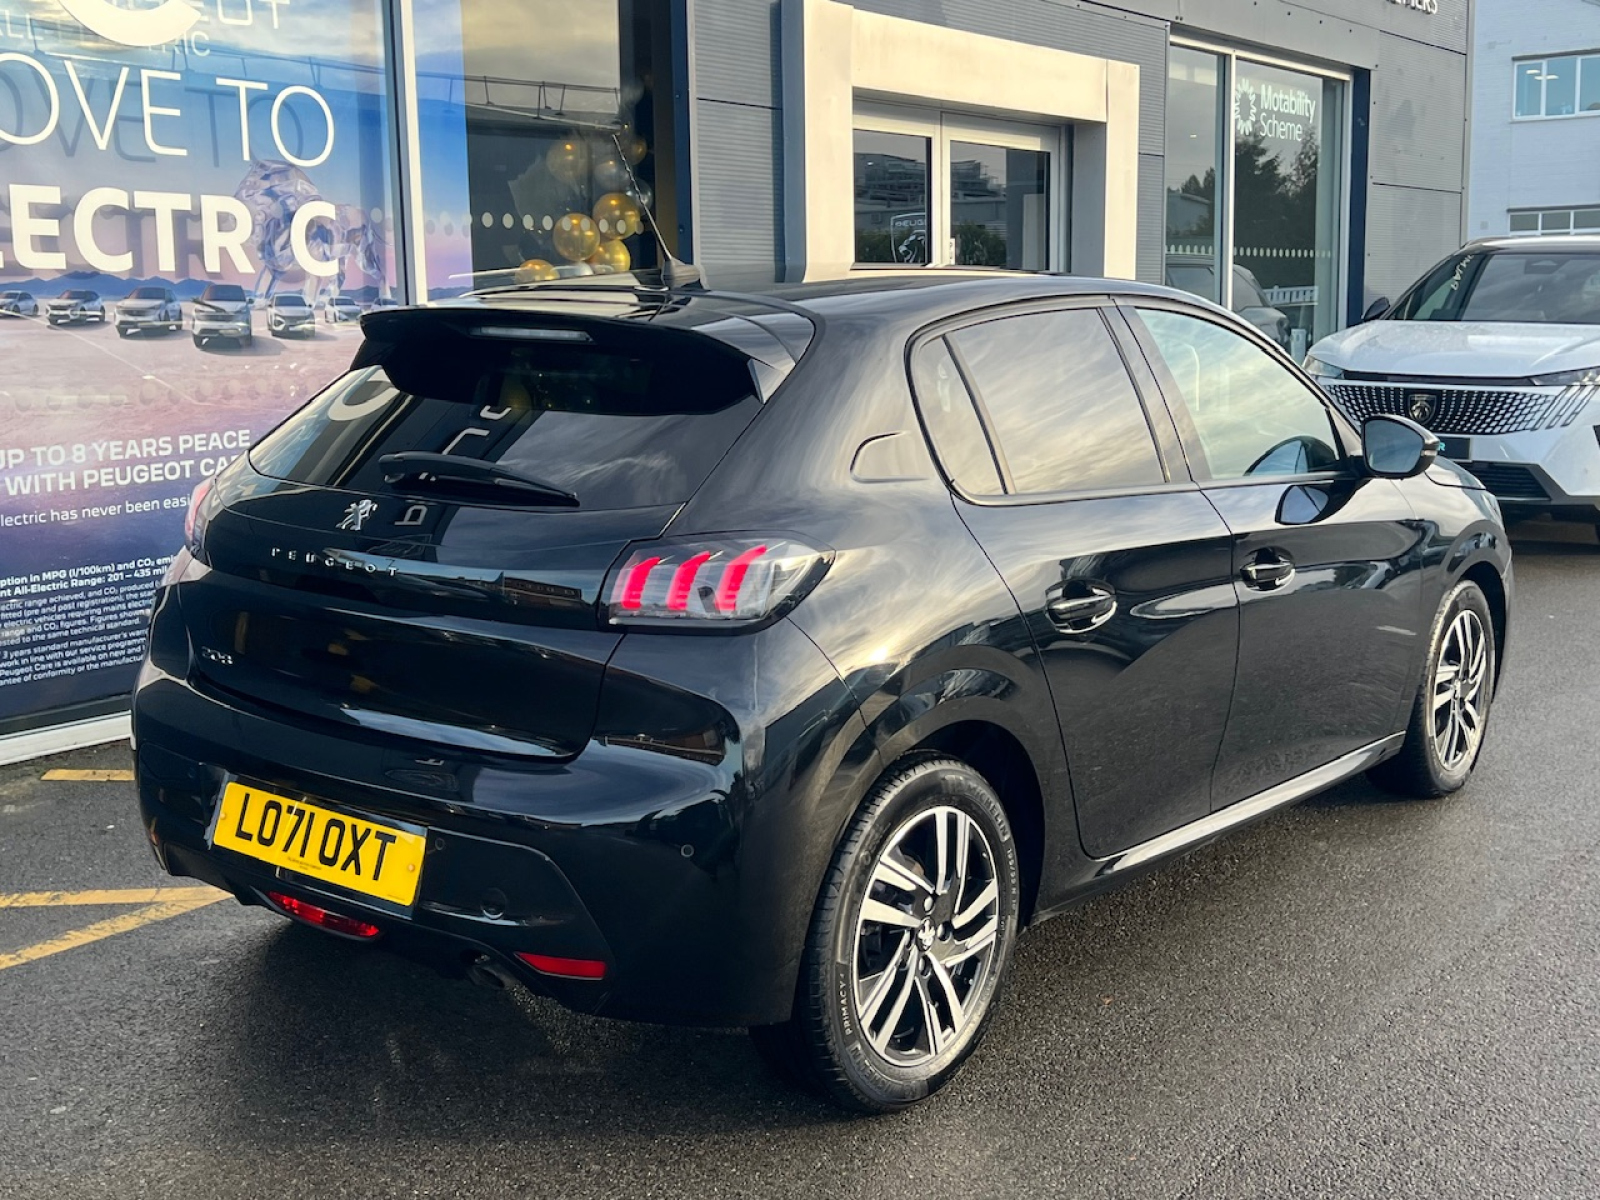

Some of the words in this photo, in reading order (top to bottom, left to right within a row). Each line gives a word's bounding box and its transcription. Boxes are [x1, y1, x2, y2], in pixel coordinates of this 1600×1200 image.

[1260, 84, 1316, 124] Motability
[216, 77, 335, 168] TO
[1260, 112, 1303, 141] Scheme
[31, 446, 66, 466] TO
[72, 444, 86, 463] 8
[91, 436, 173, 461] YEARS
[179, 429, 250, 454] PEACE
[5, 471, 76, 496] WITH
[83, 460, 195, 489] PEUGEOT
[200, 455, 238, 476] CA
[50, 508, 78, 523] has
[82, 504, 122, 518] never
[125, 499, 160, 514] been
[30, 574, 40, 583] in
[42, 569, 67, 581] MPG
[117, 560, 136, 571] and
[270, 547, 400, 577] PEUGEOT
[14, 581, 69, 596] All-Electric
[71, 576, 105, 589] Range:
[108, 572, 124, 583] 201
[134, 569, 151, 578] 435
[25, 596, 47, 608] range
[88, 588, 102, 598] and
[120, 582, 154, 594] produced
[4, 617, 33, 628] electric
[35, 612, 66, 624] vehicles
[68, 607, 101, 621] requiring
[103, 602, 126, 613] mains
[24, 605, 39, 618] (pre
[41, 603, 57, 614] and
[58, 601, 75, 613] post
[126, 592, 137, 601] the
[2, 626, 26, 639] range
[27, 623, 42, 634] and
[90, 613, 118, 626] Figures
[119, 609, 144, 620] shown
[22, 634, 31, 644] to
[32, 632, 46, 642] the
[47, 630, 69, 641] same
[70, 624, 106, 637] technical
[0, 665, 33, 678] Peugeot
[34, 662, 53, 672] Care
[54, 660, 62, 669] is
[63, 653, 97, 667] available
[98, 651, 108, 661] on
[109, 648, 126, 659] new
[127, 645, 141, 656] and
[10, 645, 31, 659] years
[33, 641, 68, 655] standard
[21, 655, 29, 665] in
[30, 652, 45, 664] line
[46, 648, 64, 661] with
[65, 647, 78, 658] our
[80, 643, 106, 656] service
[23, 673, 31, 683] of
[33, 665, 75, 681] conformity
[86, 661, 99, 672] the
[235, 793, 315, 858] LO71
[318, 818, 397, 881] OXT
